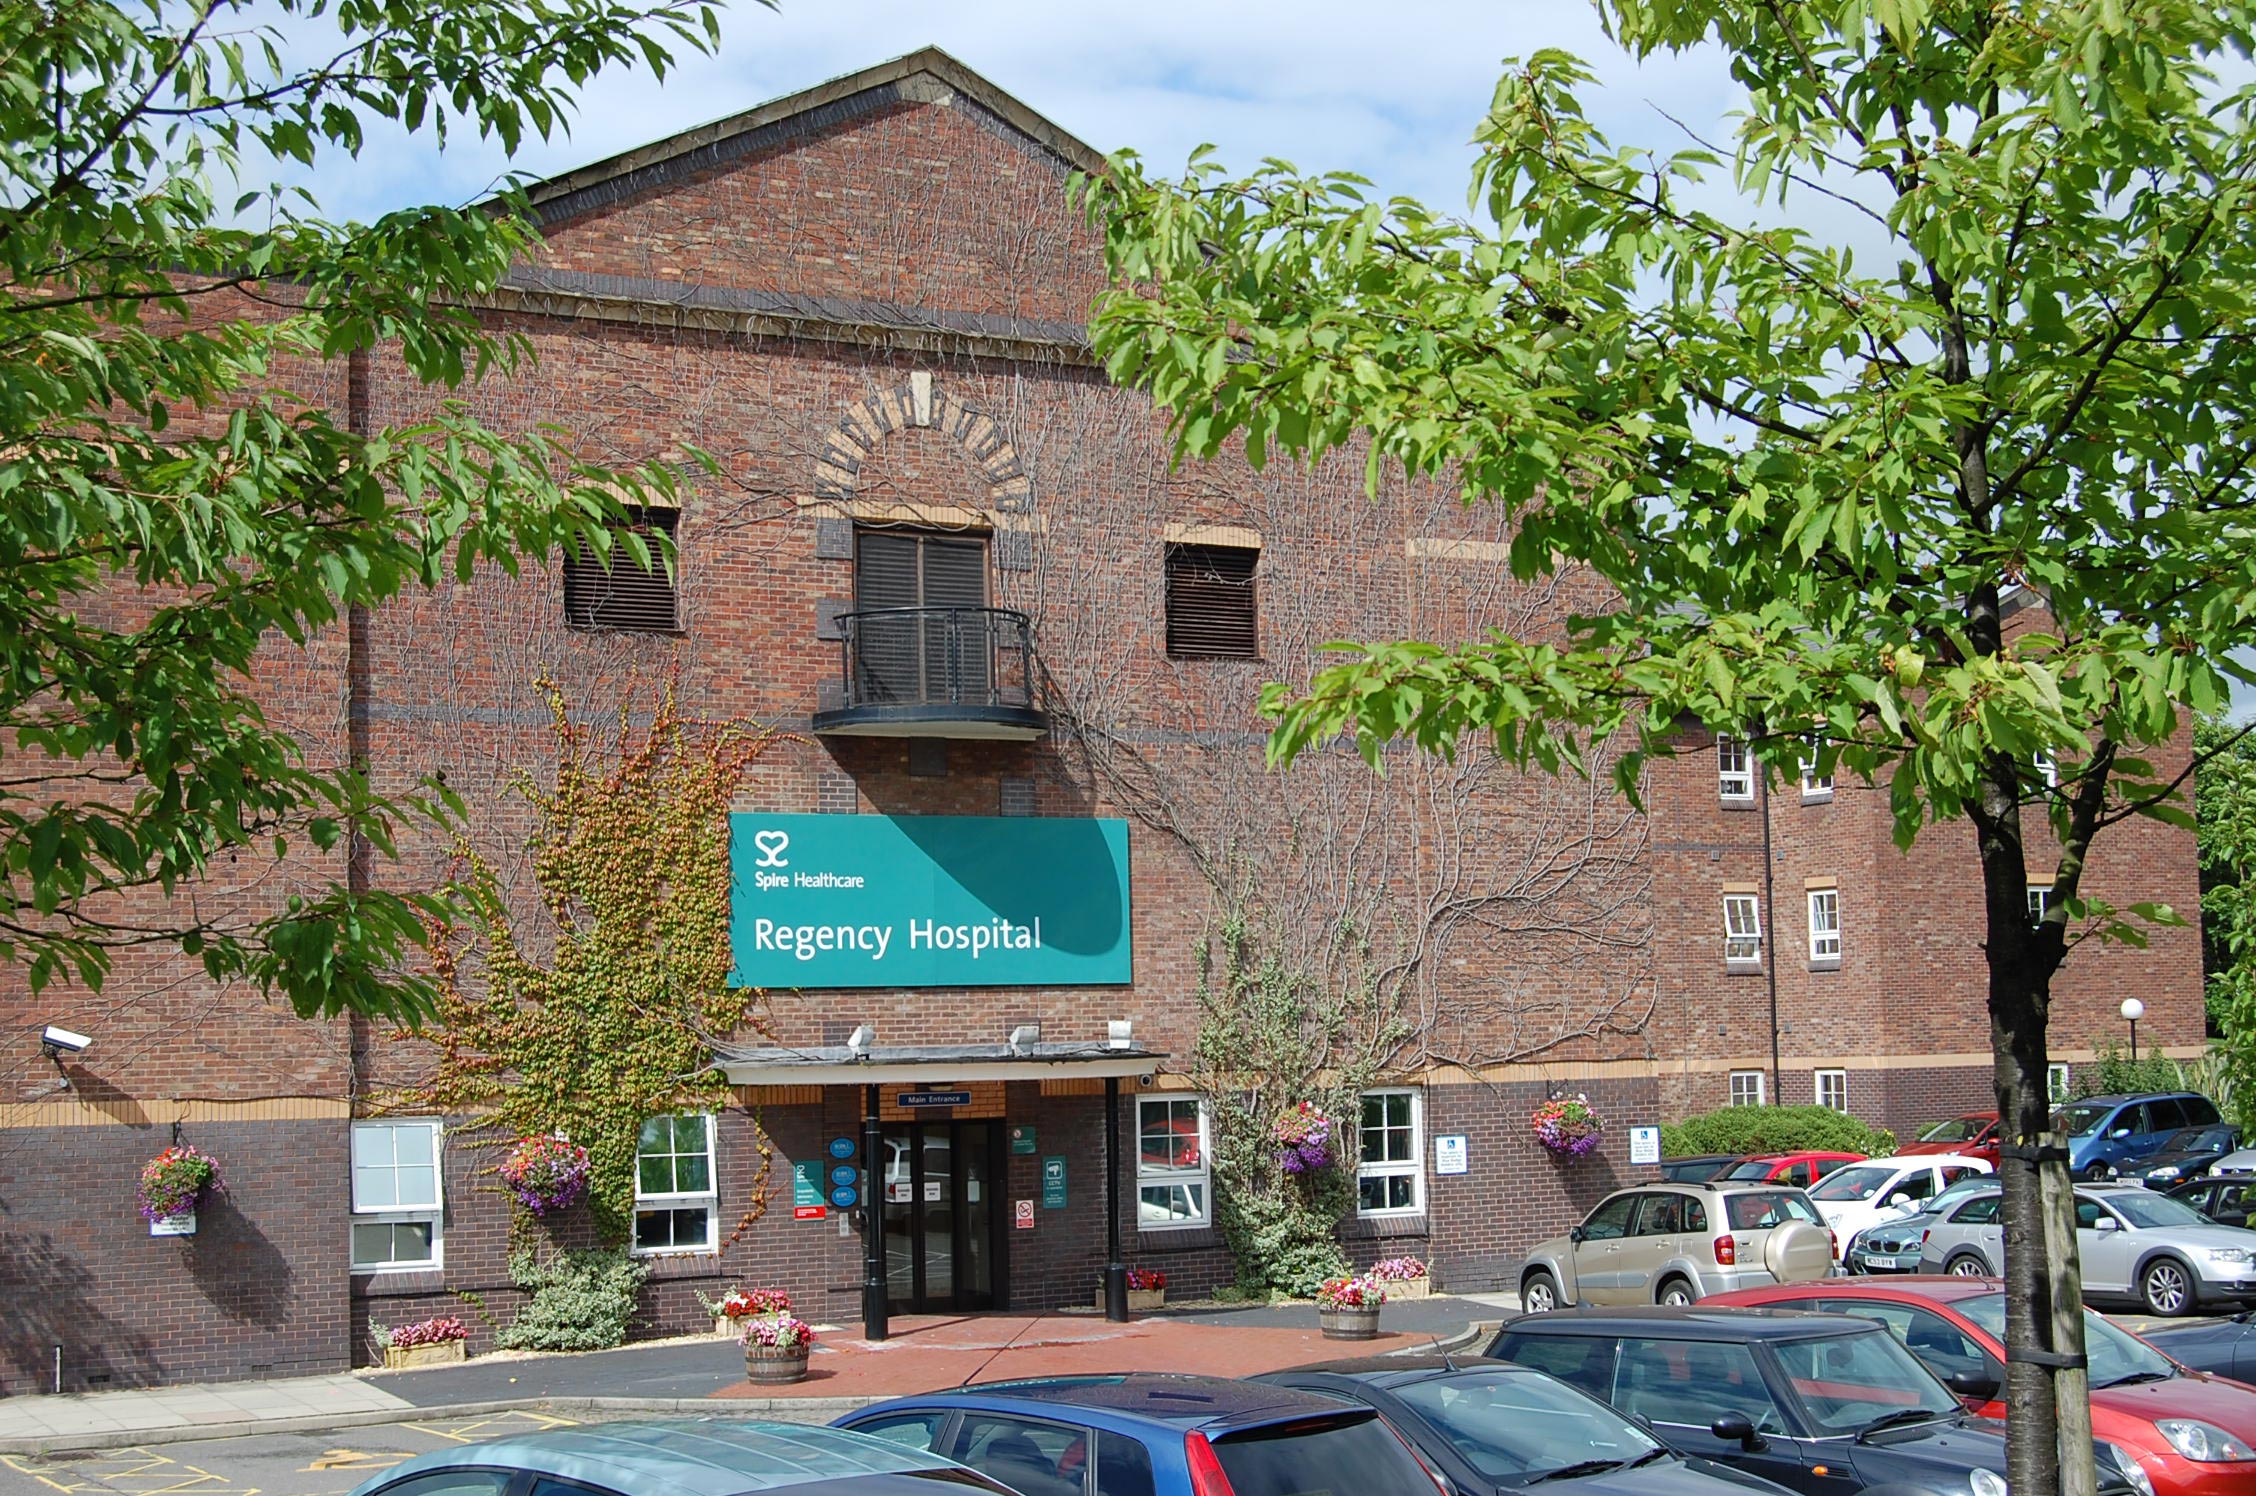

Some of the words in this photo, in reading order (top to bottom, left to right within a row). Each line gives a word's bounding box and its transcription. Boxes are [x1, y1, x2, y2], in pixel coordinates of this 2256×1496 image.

[755, 871, 789, 892] Spire
[794, 871, 865, 889] Healthcare
[755, 918, 893, 961] Regency
[910, 916, 1041, 958] Hospital
